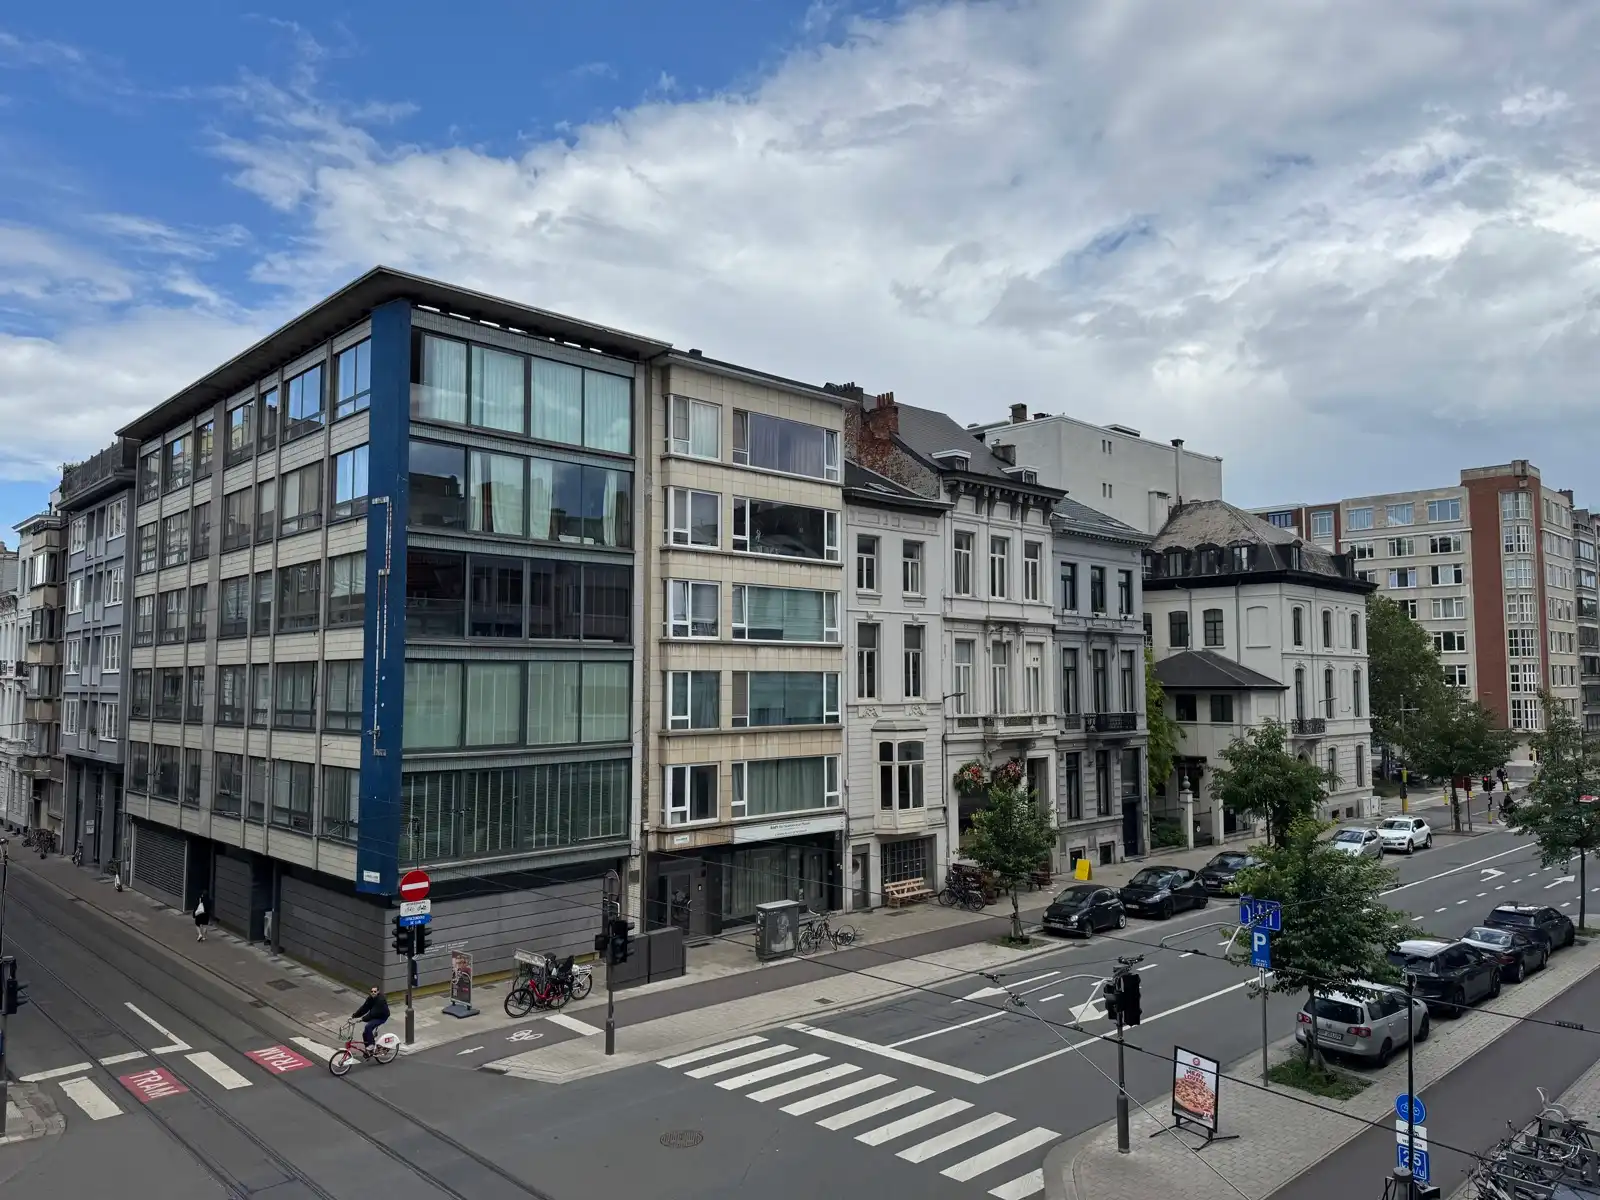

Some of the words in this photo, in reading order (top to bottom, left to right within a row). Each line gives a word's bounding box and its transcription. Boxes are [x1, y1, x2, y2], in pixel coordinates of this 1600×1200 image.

[1253, 932, 1267, 952] P
[252, 1047, 304, 1071] TRAM
[129, 1070, 179, 1099] TRAM
[1403, 1150, 1421, 1167] 25
